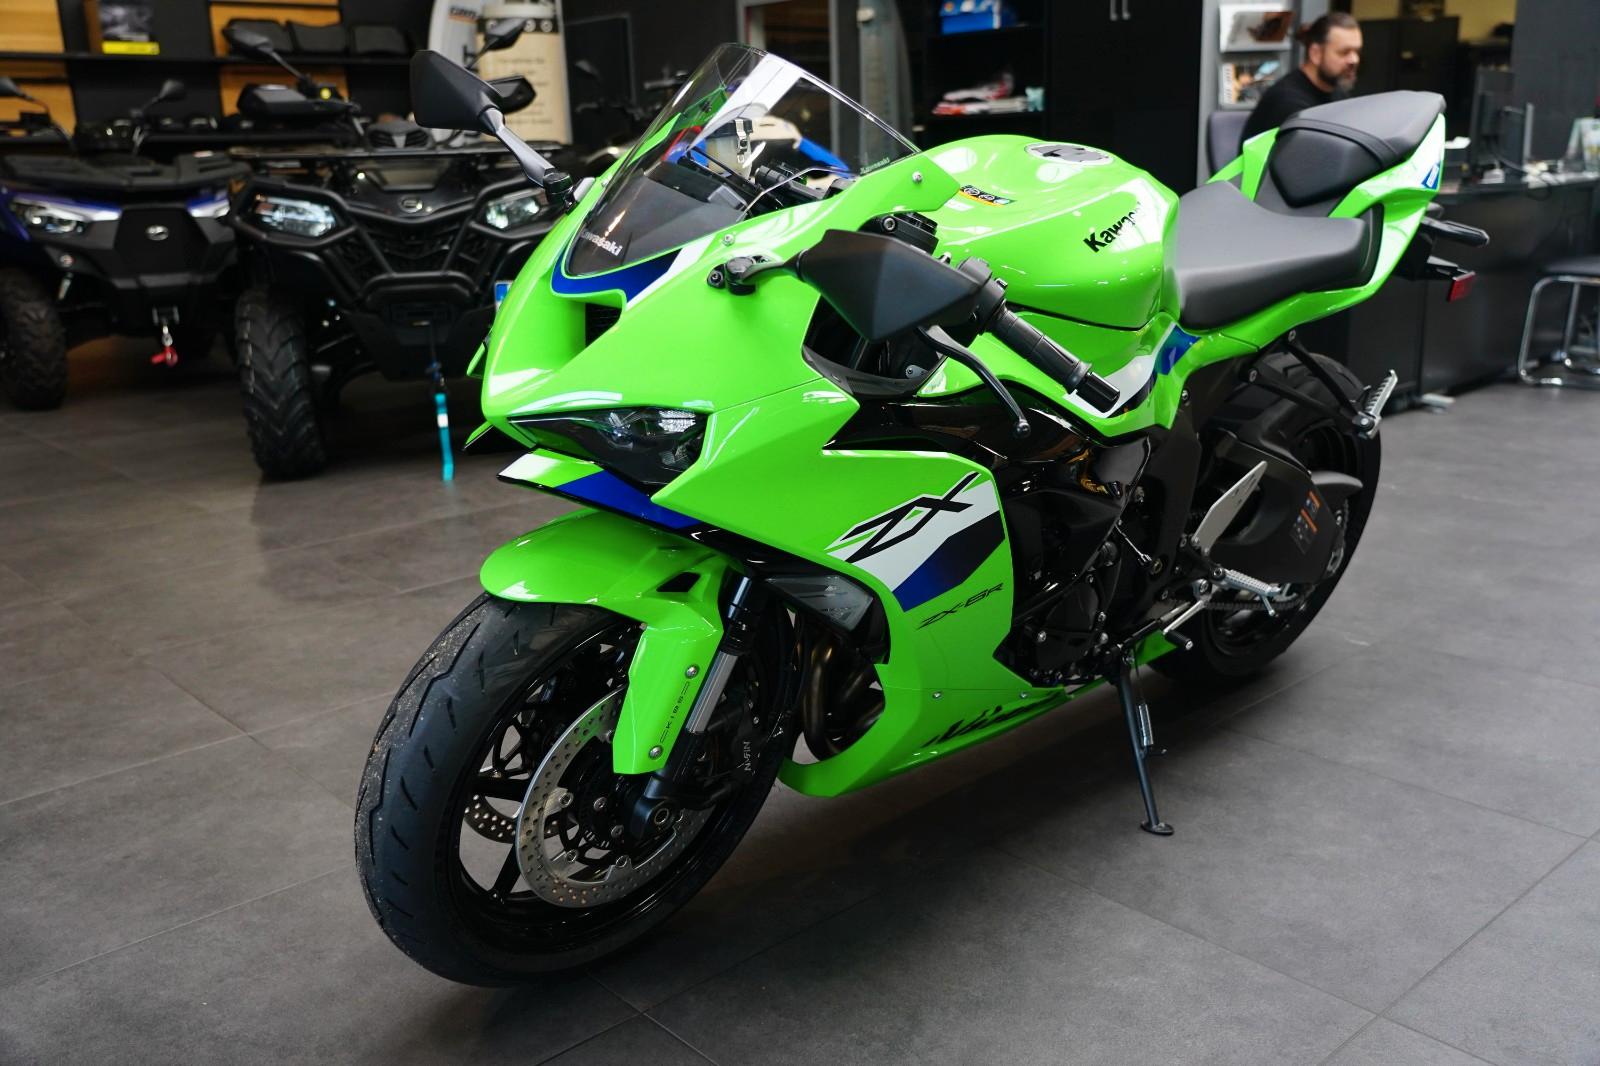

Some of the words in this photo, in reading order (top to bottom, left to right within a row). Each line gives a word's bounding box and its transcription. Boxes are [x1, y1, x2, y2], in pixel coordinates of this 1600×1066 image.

[1083, 201, 1141, 253] Kawa
[839, 471, 975, 564] ZX
[916, 582, 1004, 631] ZX-6R
[743, 741, 753, 771] NSIN
